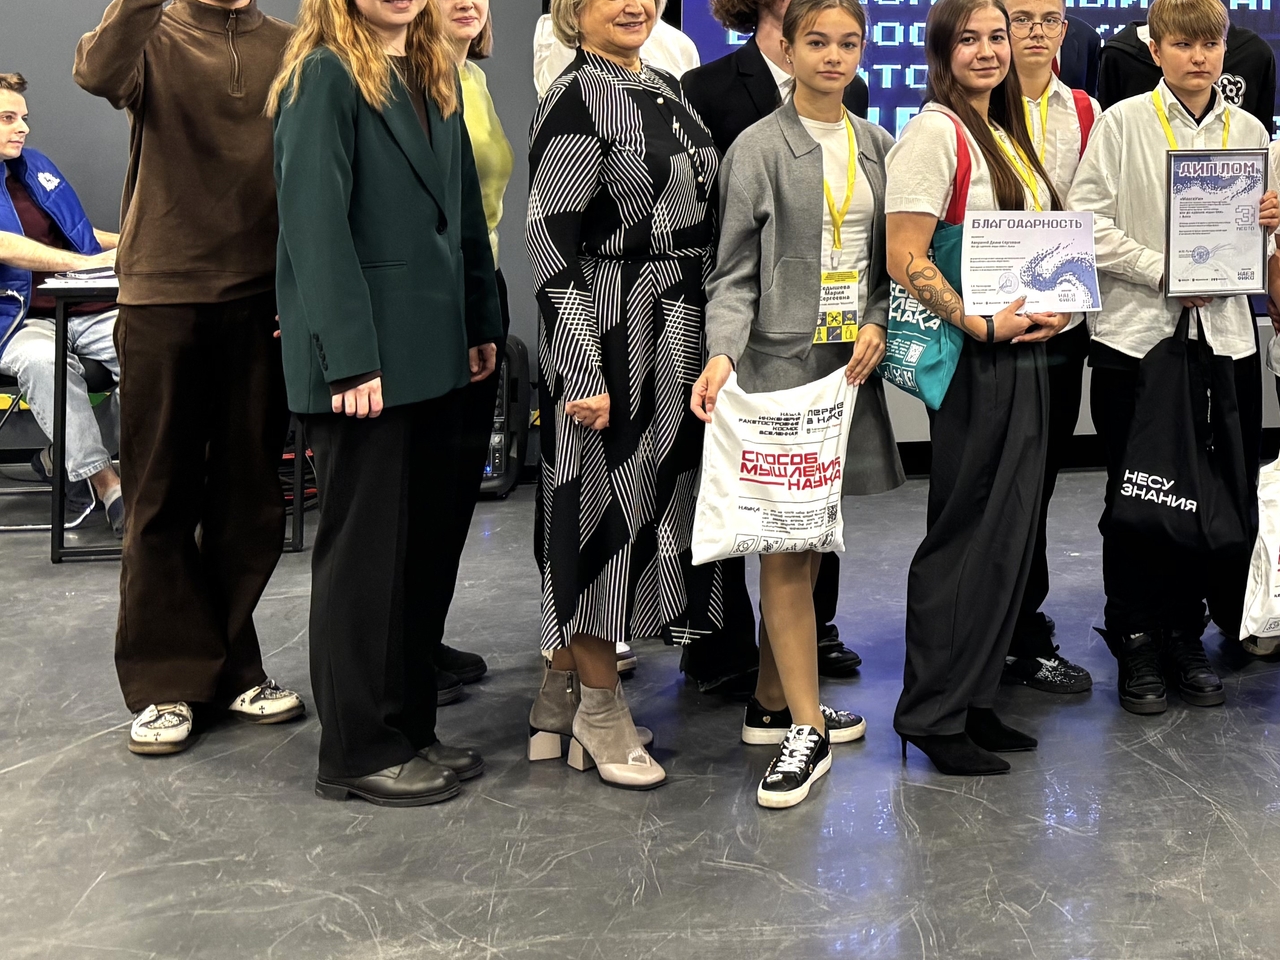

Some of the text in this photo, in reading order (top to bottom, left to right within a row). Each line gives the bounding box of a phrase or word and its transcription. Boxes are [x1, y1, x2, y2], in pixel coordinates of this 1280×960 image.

[1180, 162, 1256, 176] ДИПЛОМ
[972, 219, 1082, 229] БЛАГОДАРНОСТЬ
[1235, 205, 1255, 226] 3
[742, 450, 818, 466] СПОСОБ
[788, 469, 840, 490] НАУКА
[1123, 469, 1174, 490] НЕСУ
[1120, 483, 1197, 512] ЗНАНИЯ
